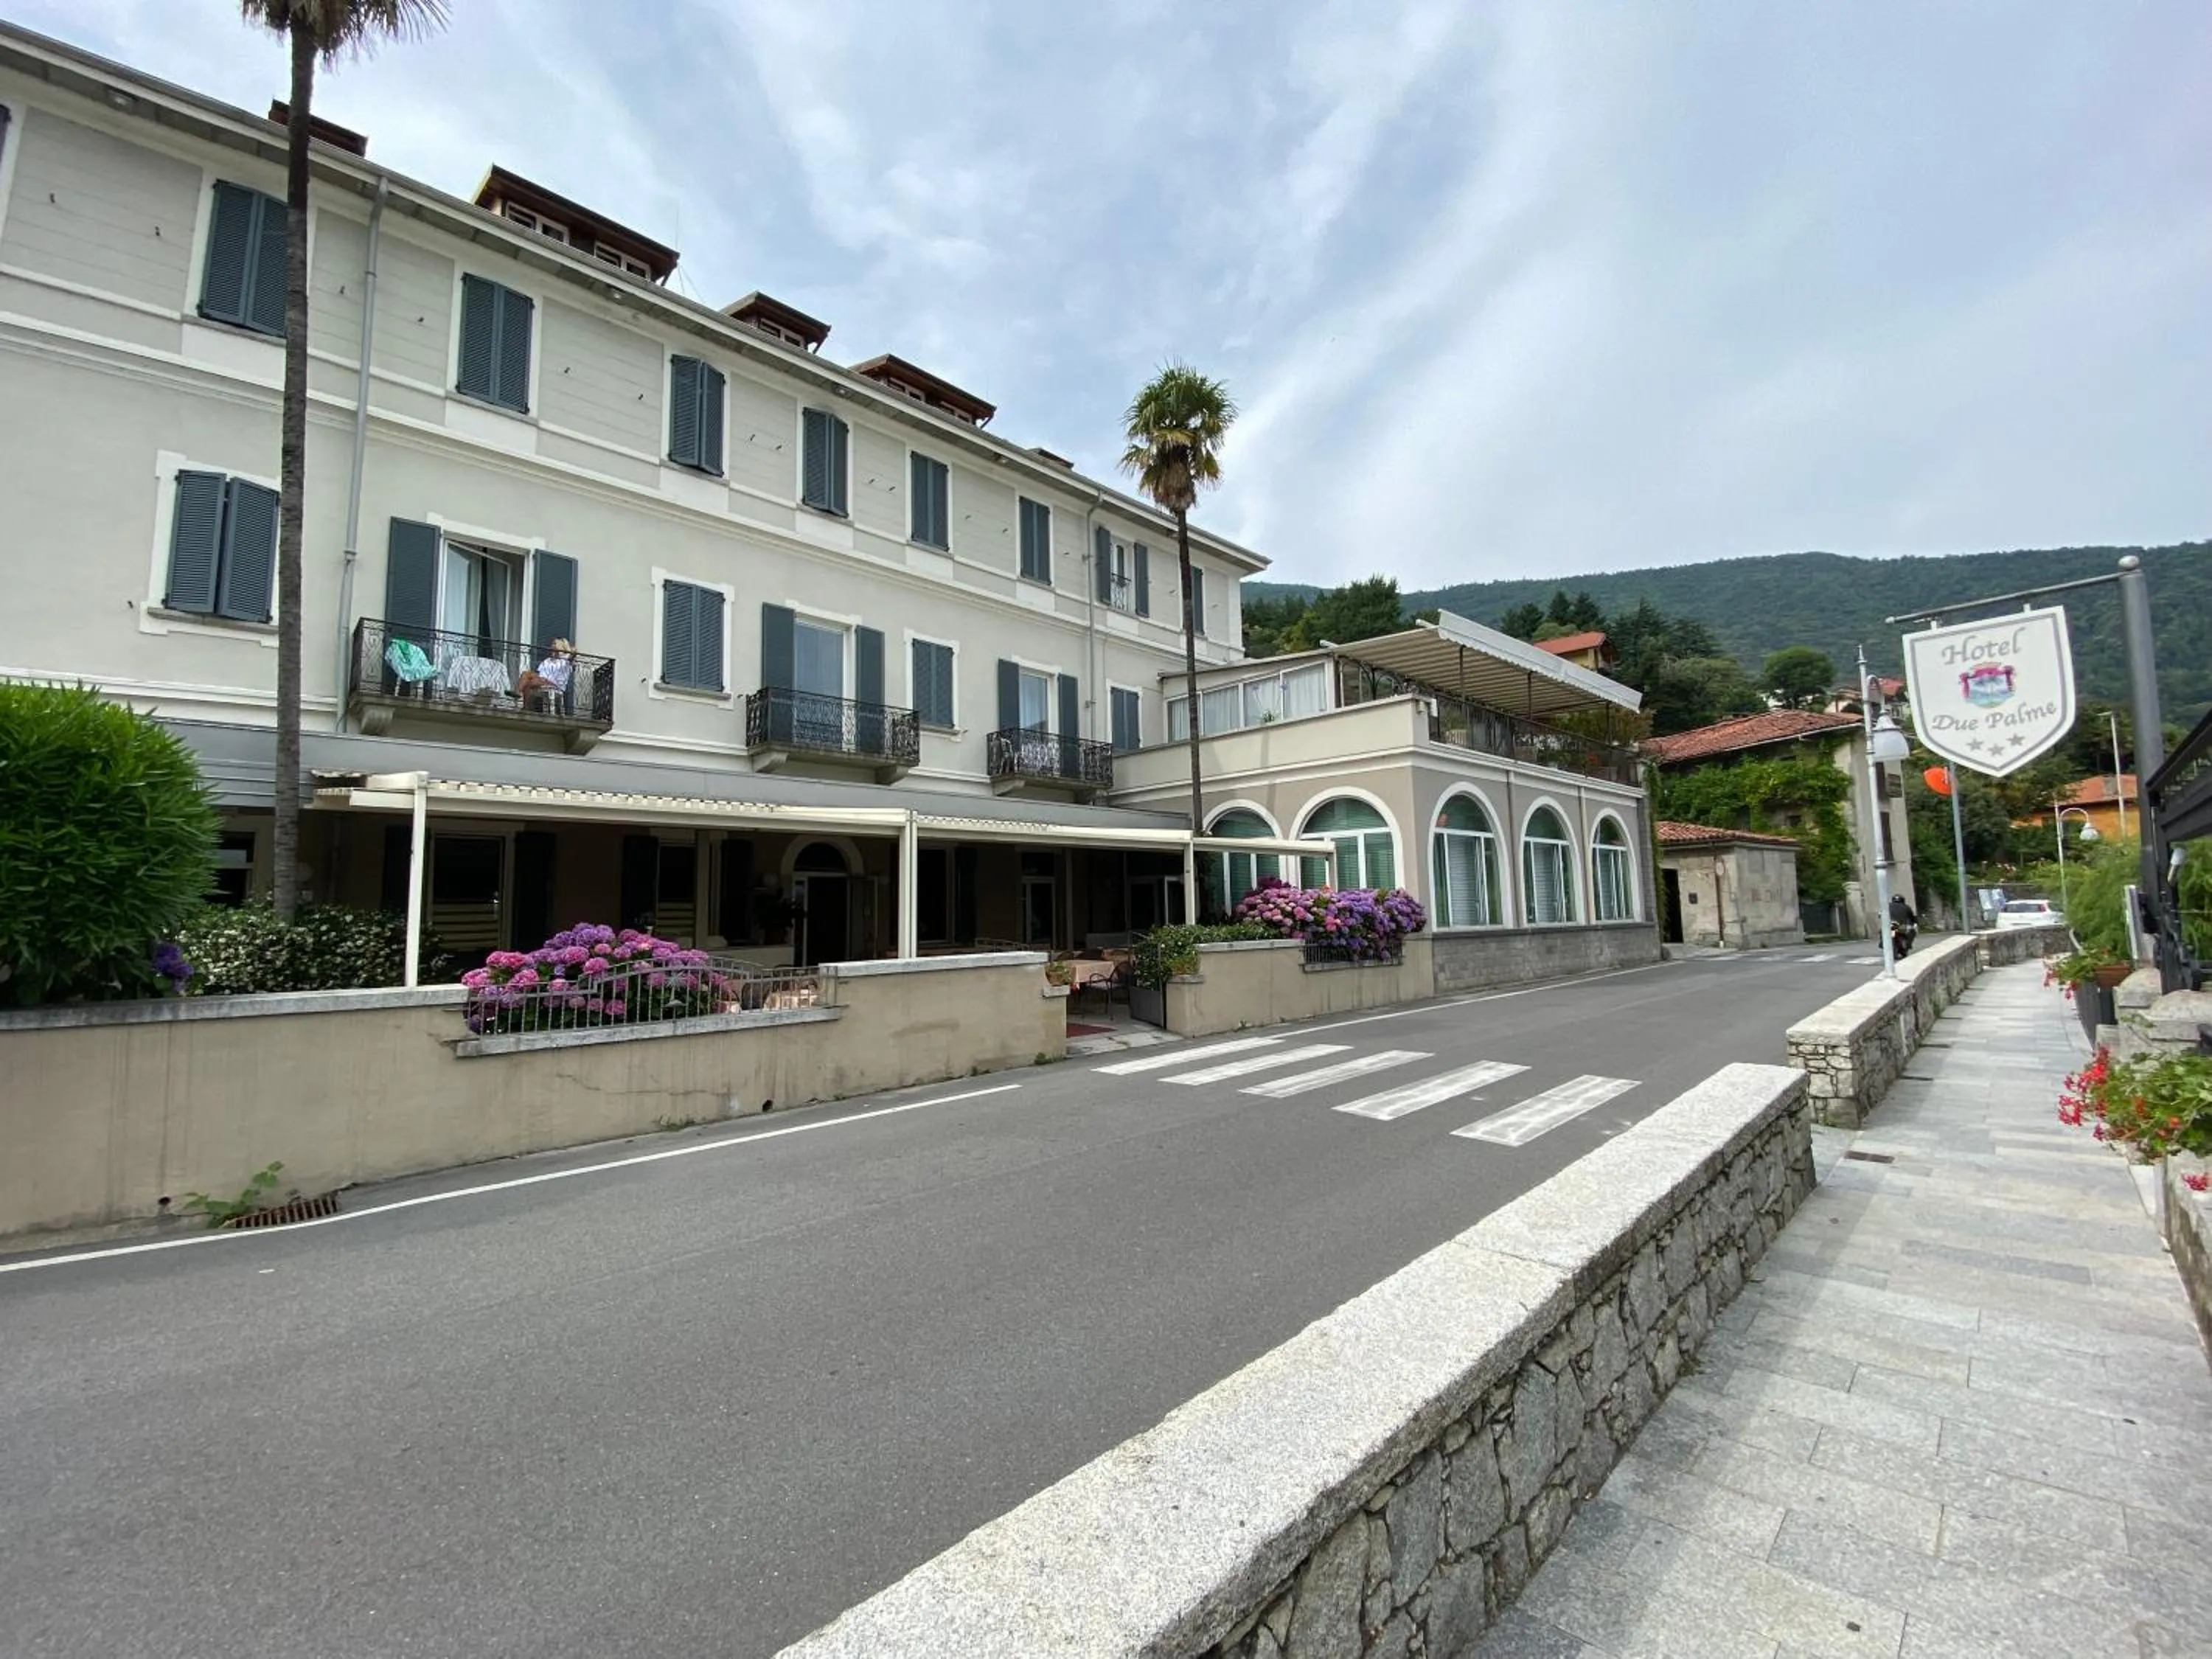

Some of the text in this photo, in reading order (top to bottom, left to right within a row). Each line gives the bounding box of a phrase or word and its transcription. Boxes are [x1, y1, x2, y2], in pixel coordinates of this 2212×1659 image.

[1941, 627, 2025, 665] Hotel
[1933, 701, 2056, 731] Due Palme
